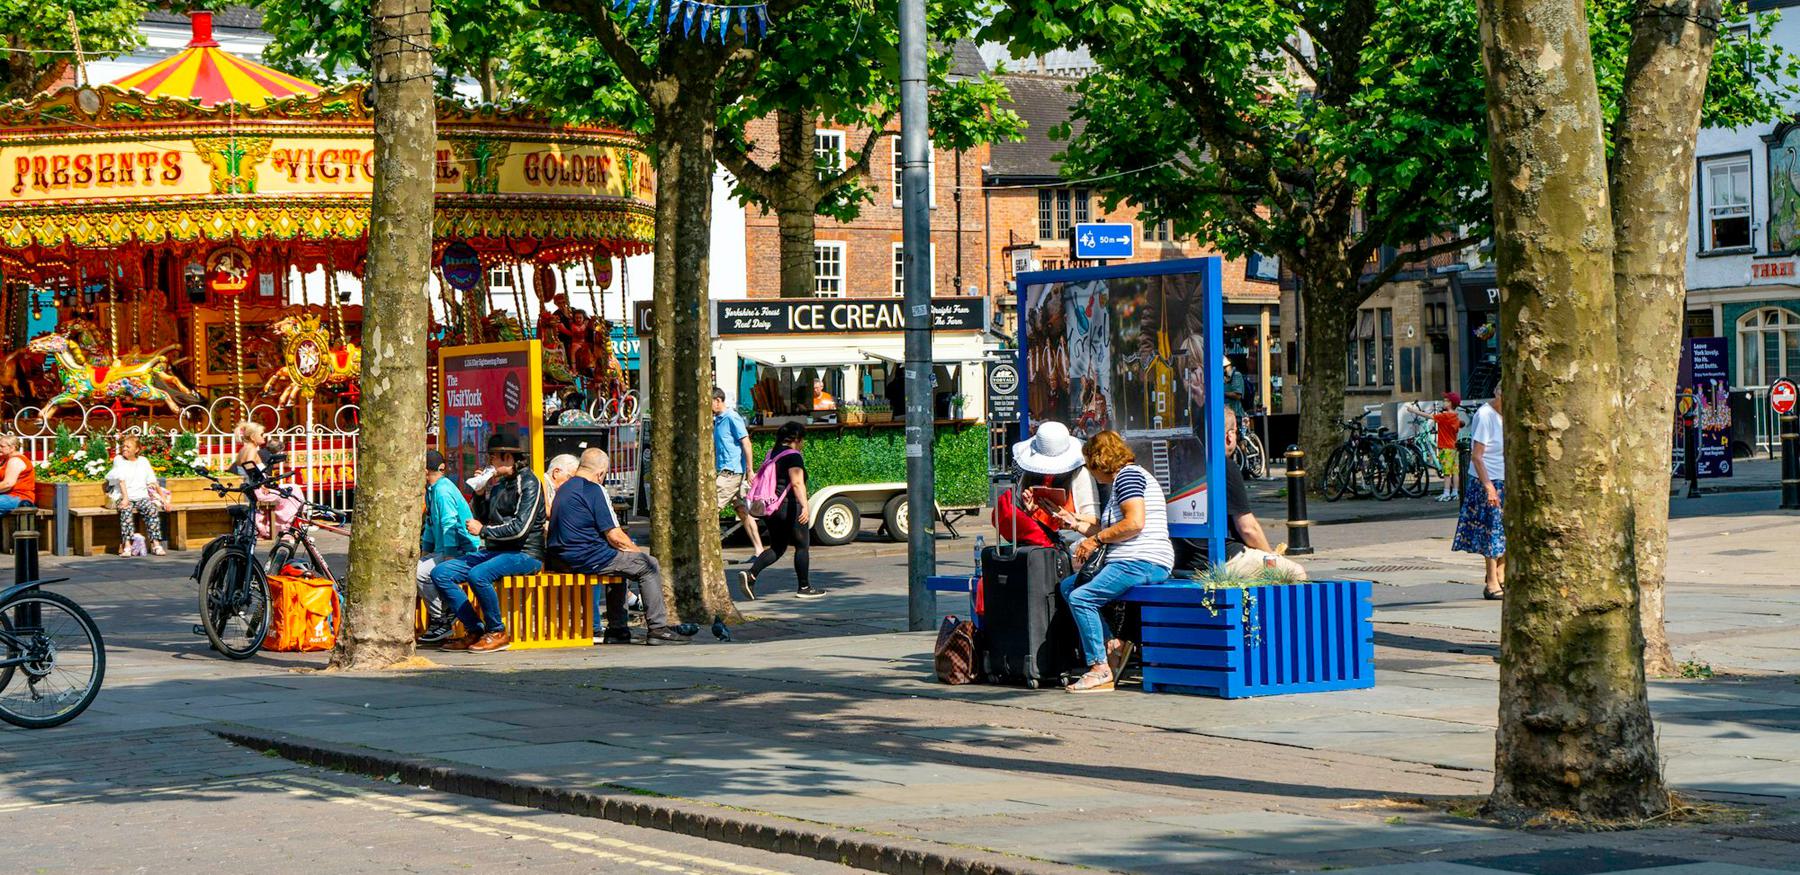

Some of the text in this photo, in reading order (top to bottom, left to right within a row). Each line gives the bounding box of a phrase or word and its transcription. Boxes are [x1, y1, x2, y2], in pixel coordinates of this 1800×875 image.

[12, 151, 183, 193] PRESENTS
[524, 152, 609, 182] GOLDEN
[1751, 262, 1795, 279] THREE
[724, 306, 781, 318] Yorkshire's Finest
[952, 304, 970, 314] From
[787, 304, 826, 330] ICE
[934, 316, 963, 326] The Farm
[733, 319, 772, 331] Real Dairy
[447, 375, 458, 386] The
[464, 410, 483, 427] Pass
